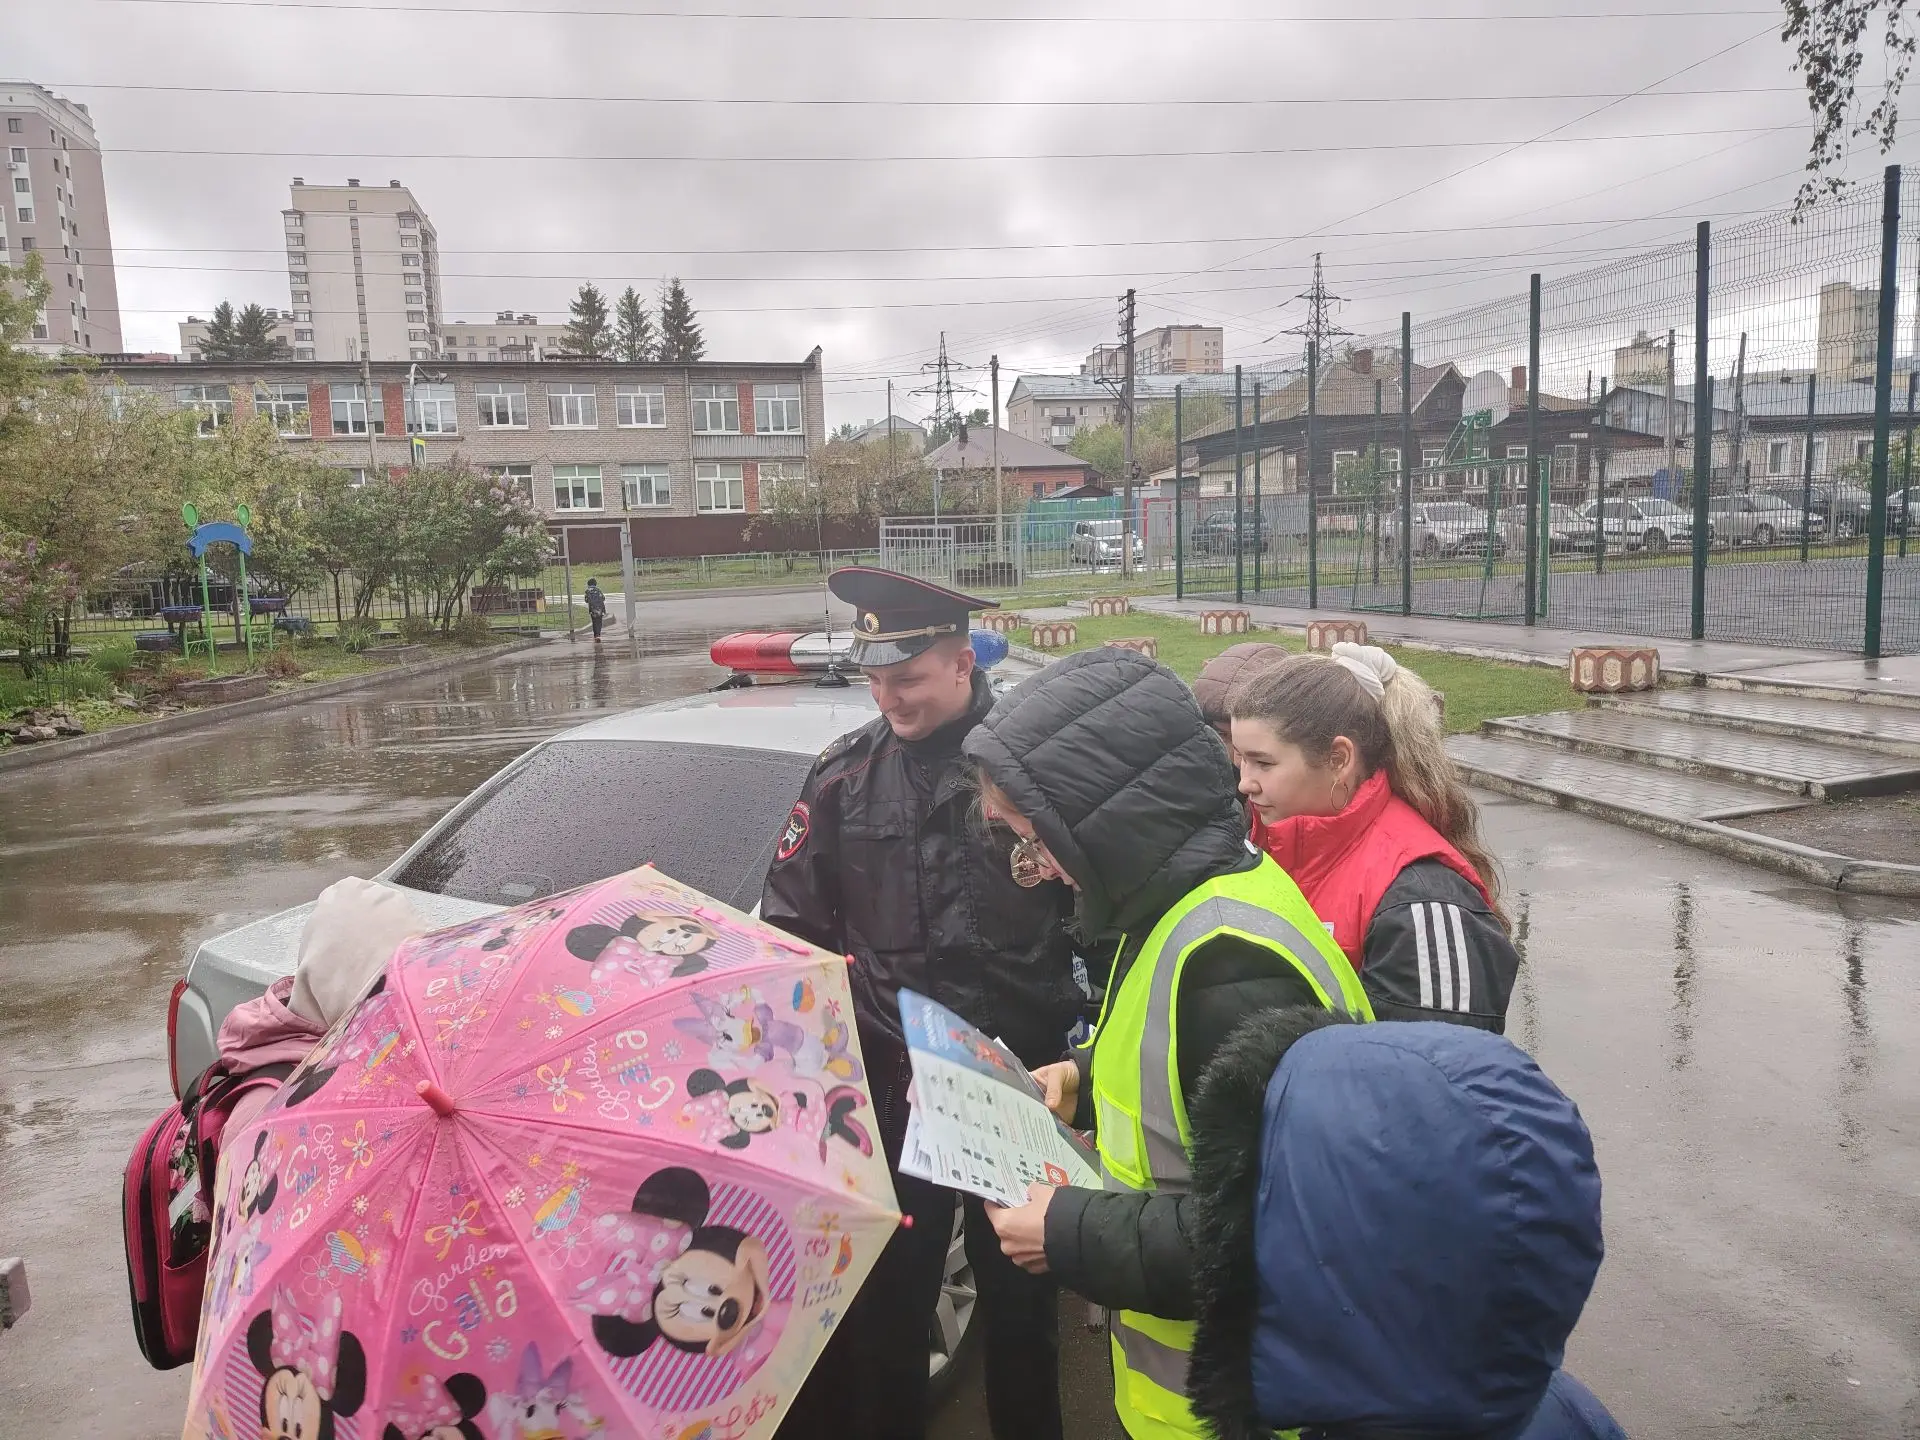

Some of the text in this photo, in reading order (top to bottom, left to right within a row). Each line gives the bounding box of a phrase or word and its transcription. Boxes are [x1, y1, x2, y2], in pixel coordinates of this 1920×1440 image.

[575, 1036, 631, 1121] Garden
[608, 1029, 676, 1110] Gala
[284, 1143, 324, 1230] Gala
[311, 1123, 346, 1208] Garden
[408, 1243, 519, 1316] Garden
[421, 1278, 518, 1361] Gala
